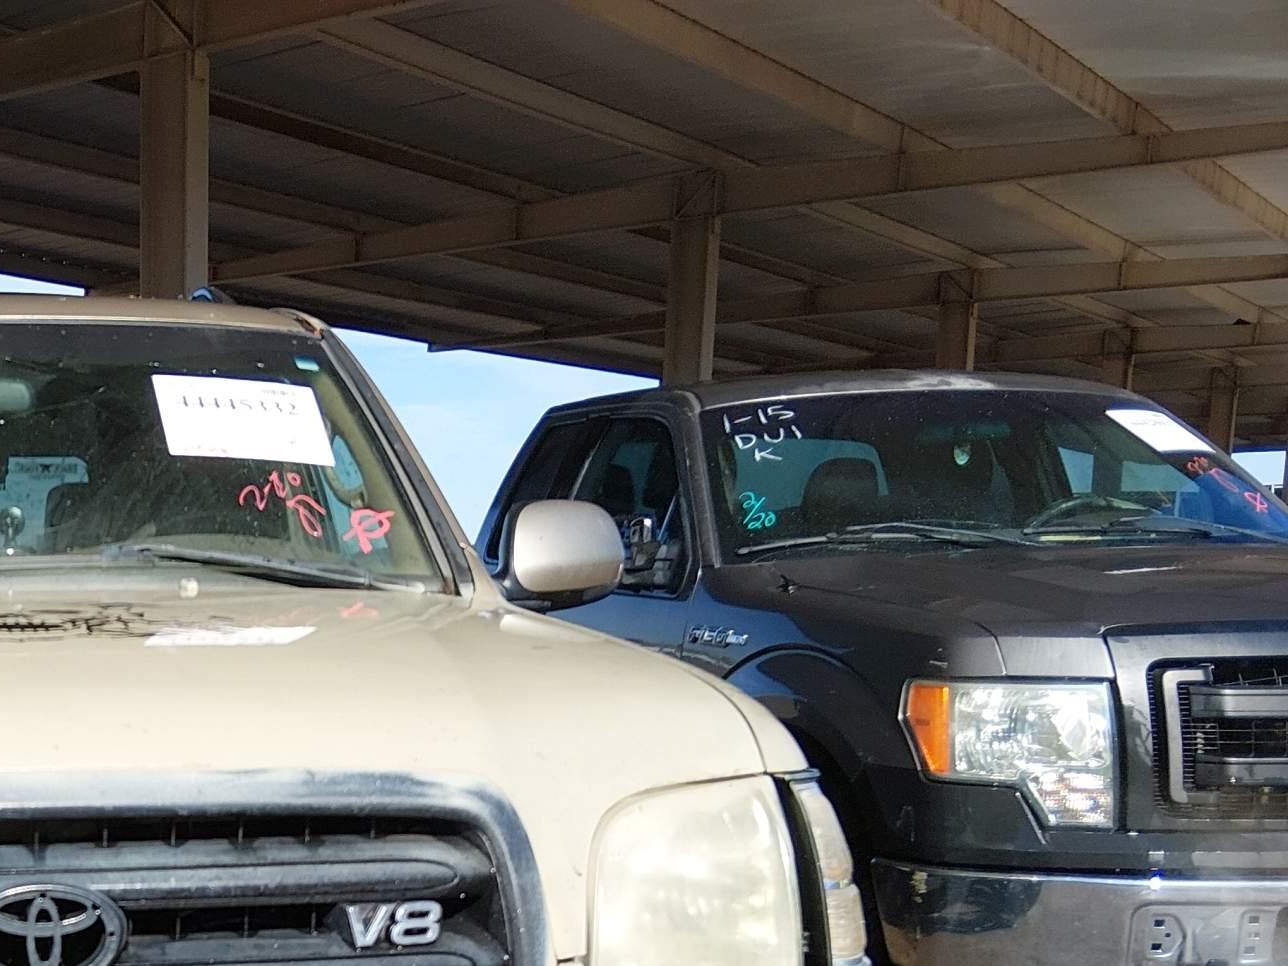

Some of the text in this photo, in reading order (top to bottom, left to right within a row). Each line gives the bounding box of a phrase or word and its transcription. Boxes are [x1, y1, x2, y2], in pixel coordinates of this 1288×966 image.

[722, 404, 795, 434] 1-15
[734, 424, 803, 450] DUI
[754, 447, 784, 462] K
[344, 899, 444, 949] V8
